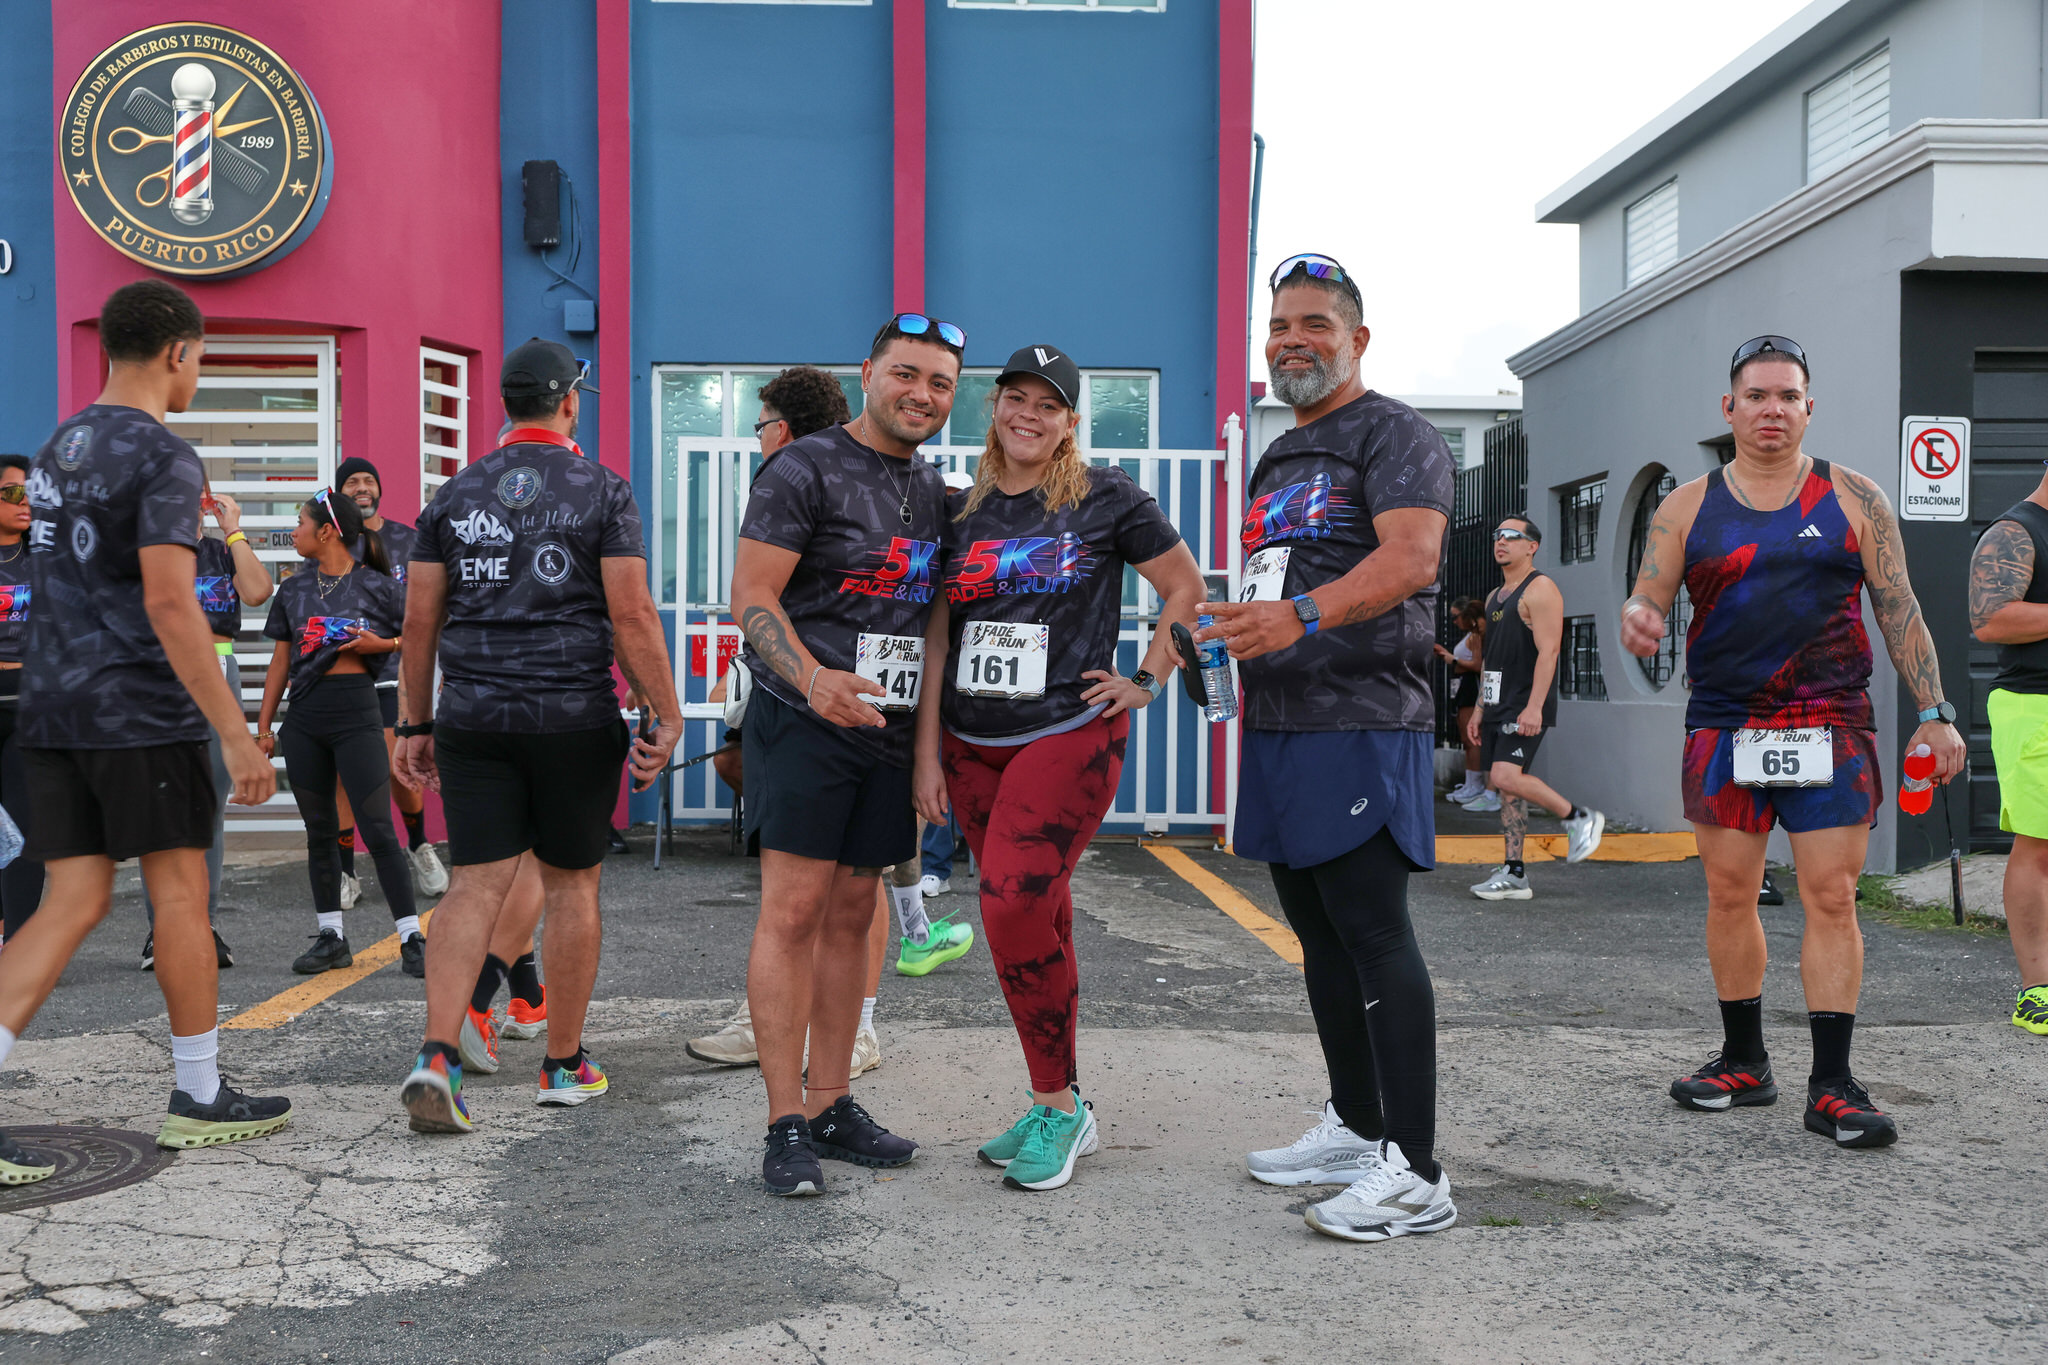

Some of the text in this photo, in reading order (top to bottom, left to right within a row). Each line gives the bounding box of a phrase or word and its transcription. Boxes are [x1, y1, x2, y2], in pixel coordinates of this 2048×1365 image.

[70, 91, 97, 157] COLEGIO
[90, 72, 111, 94] DE
[105, 35, 179, 78] BARBEROS
[180, 34, 191, 47] Y
[193, 34, 270, 74] ESTILISTAS
[266, 69, 287, 90] EN
[239, 135, 275, 150] 1989
[104, 215, 275, 264] PUERTO RICO
[1908, 495, 1961, 506] ESTACIONAR
[1928, 484, 1941, 494] NO
[1241, 482, 1309, 543] 5K
[460, 556, 510, 581] EME
[875, 536, 937, 586] 5K
[957, 536, 1057, 585] 5K
[838, 577, 899, 598] FADE
[894, 584, 908, 600] &
[997, 581, 1014, 595] &
[304, 616, 356, 641] 5K
[982, 624, 1017, 638] FADE
[702, 647, 727, 657] PRA
[891, 639, 916, 652] FADE
[996, 637, 1027, 648] RUN
[902, 652, 921, 662] RUN
[971, 654, 1019, 686] 161
[877, 669, 919, 699] 147
[1783, 733, 1811, 742] RUN
[1762, 749, 1800, 776] 65
